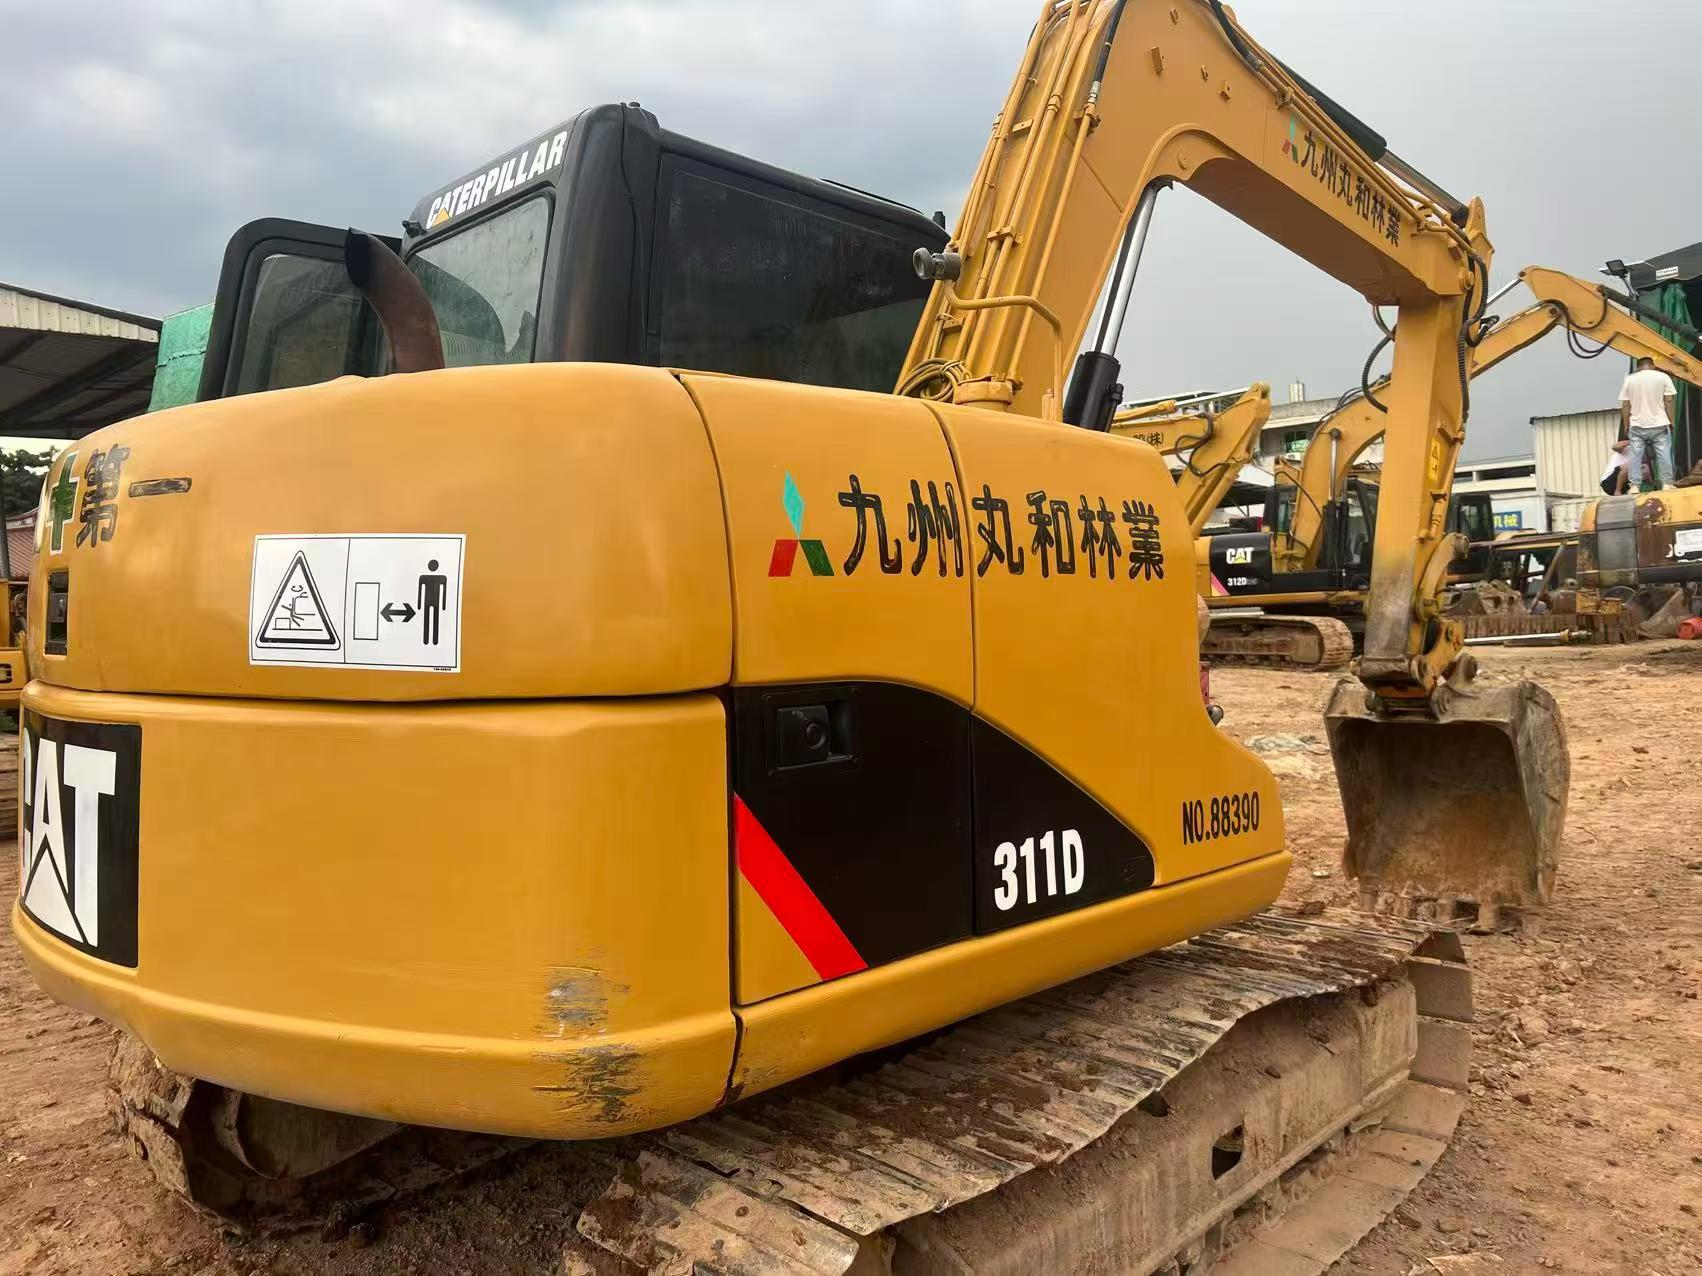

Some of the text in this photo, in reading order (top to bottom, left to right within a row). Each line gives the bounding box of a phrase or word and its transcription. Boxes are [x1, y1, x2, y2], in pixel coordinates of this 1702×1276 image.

[426, 131, 567, 229] CATERPILLAR
[1301, 130, 1401, 247] 九州丸和林業
[838, 474, 1164, 581] 九州丸和林業
[1226, 547, 1254, 564] CAT
[1182, 791, 1260, 845] NO.88390
[993, 829, 1085, 911] 311D
